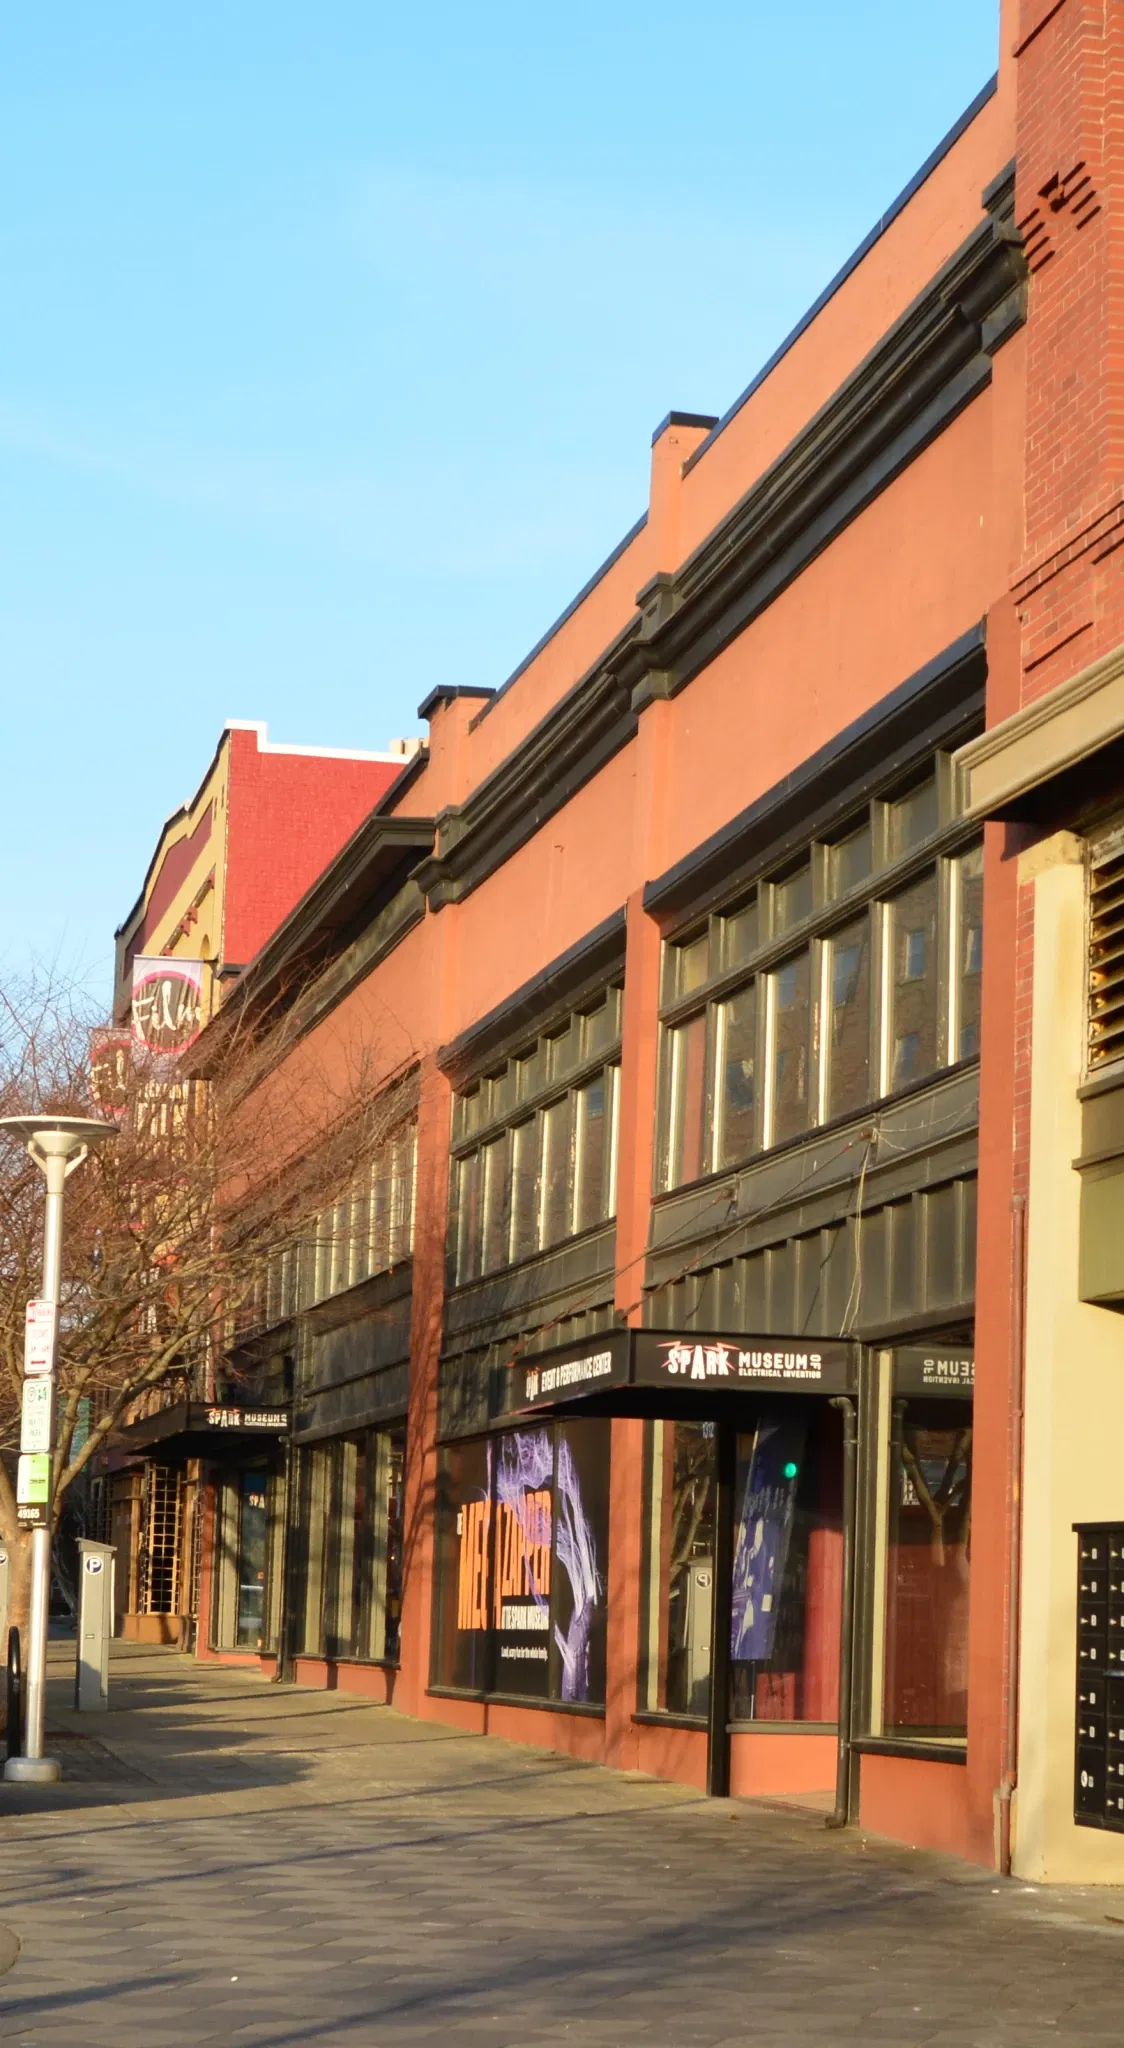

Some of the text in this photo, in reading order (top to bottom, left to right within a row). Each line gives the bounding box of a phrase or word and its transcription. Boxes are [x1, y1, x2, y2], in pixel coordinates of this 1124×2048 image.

[131, 980, 200, 1042] Film
[593, 1351, 612, 1377] CENTER
[668, 1345, 729, 1380] SPARK
[738, 1351, 822, 1370] MUSEUM OF
[738, 1367, 822, 1379] ELECTRICAL INVENTION
[208, 1410, 240, 1428] SPARK
[244, 1413, 281, 1423] MUSEUM
